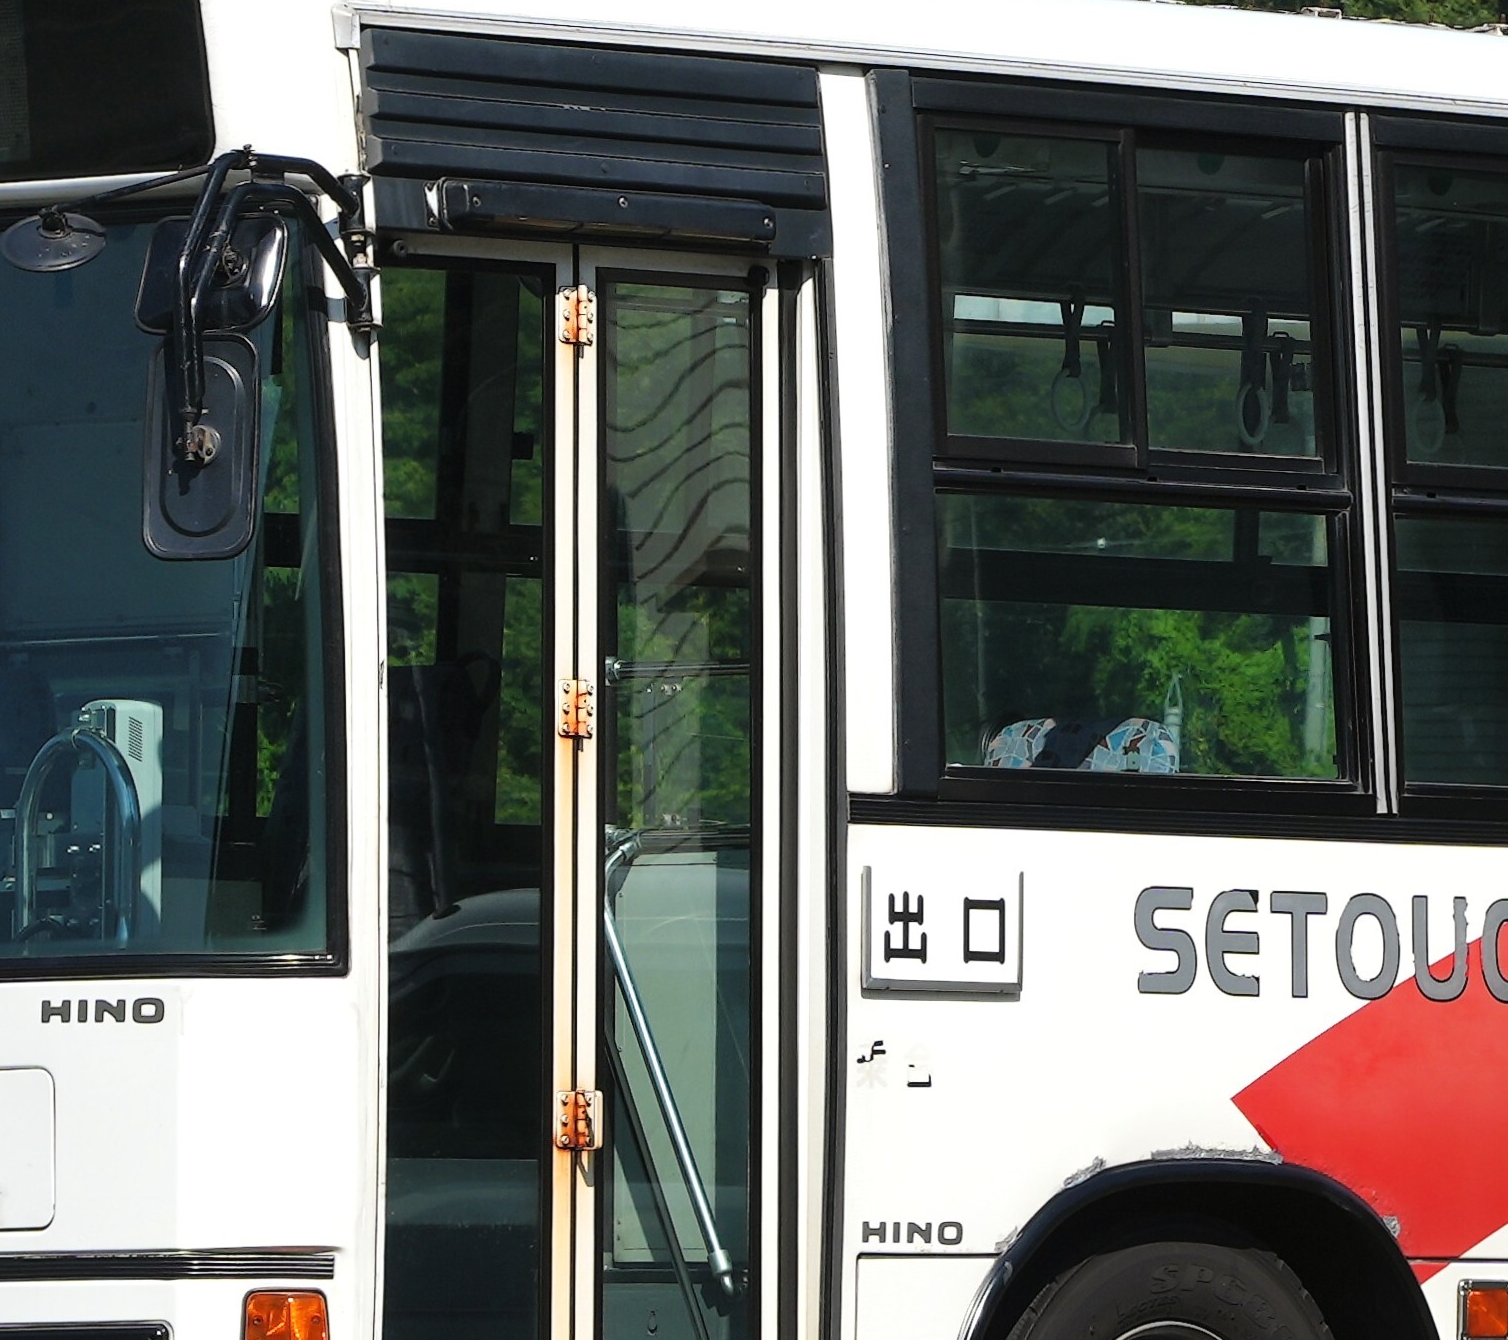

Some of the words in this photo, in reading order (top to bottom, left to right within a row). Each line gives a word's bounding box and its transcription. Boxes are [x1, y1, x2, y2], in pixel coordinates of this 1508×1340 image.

[883, 889, 1007, 966] 出口
[41, 996, 166, 1024] HINO
[861, 1221, 964, 1246] HINO
